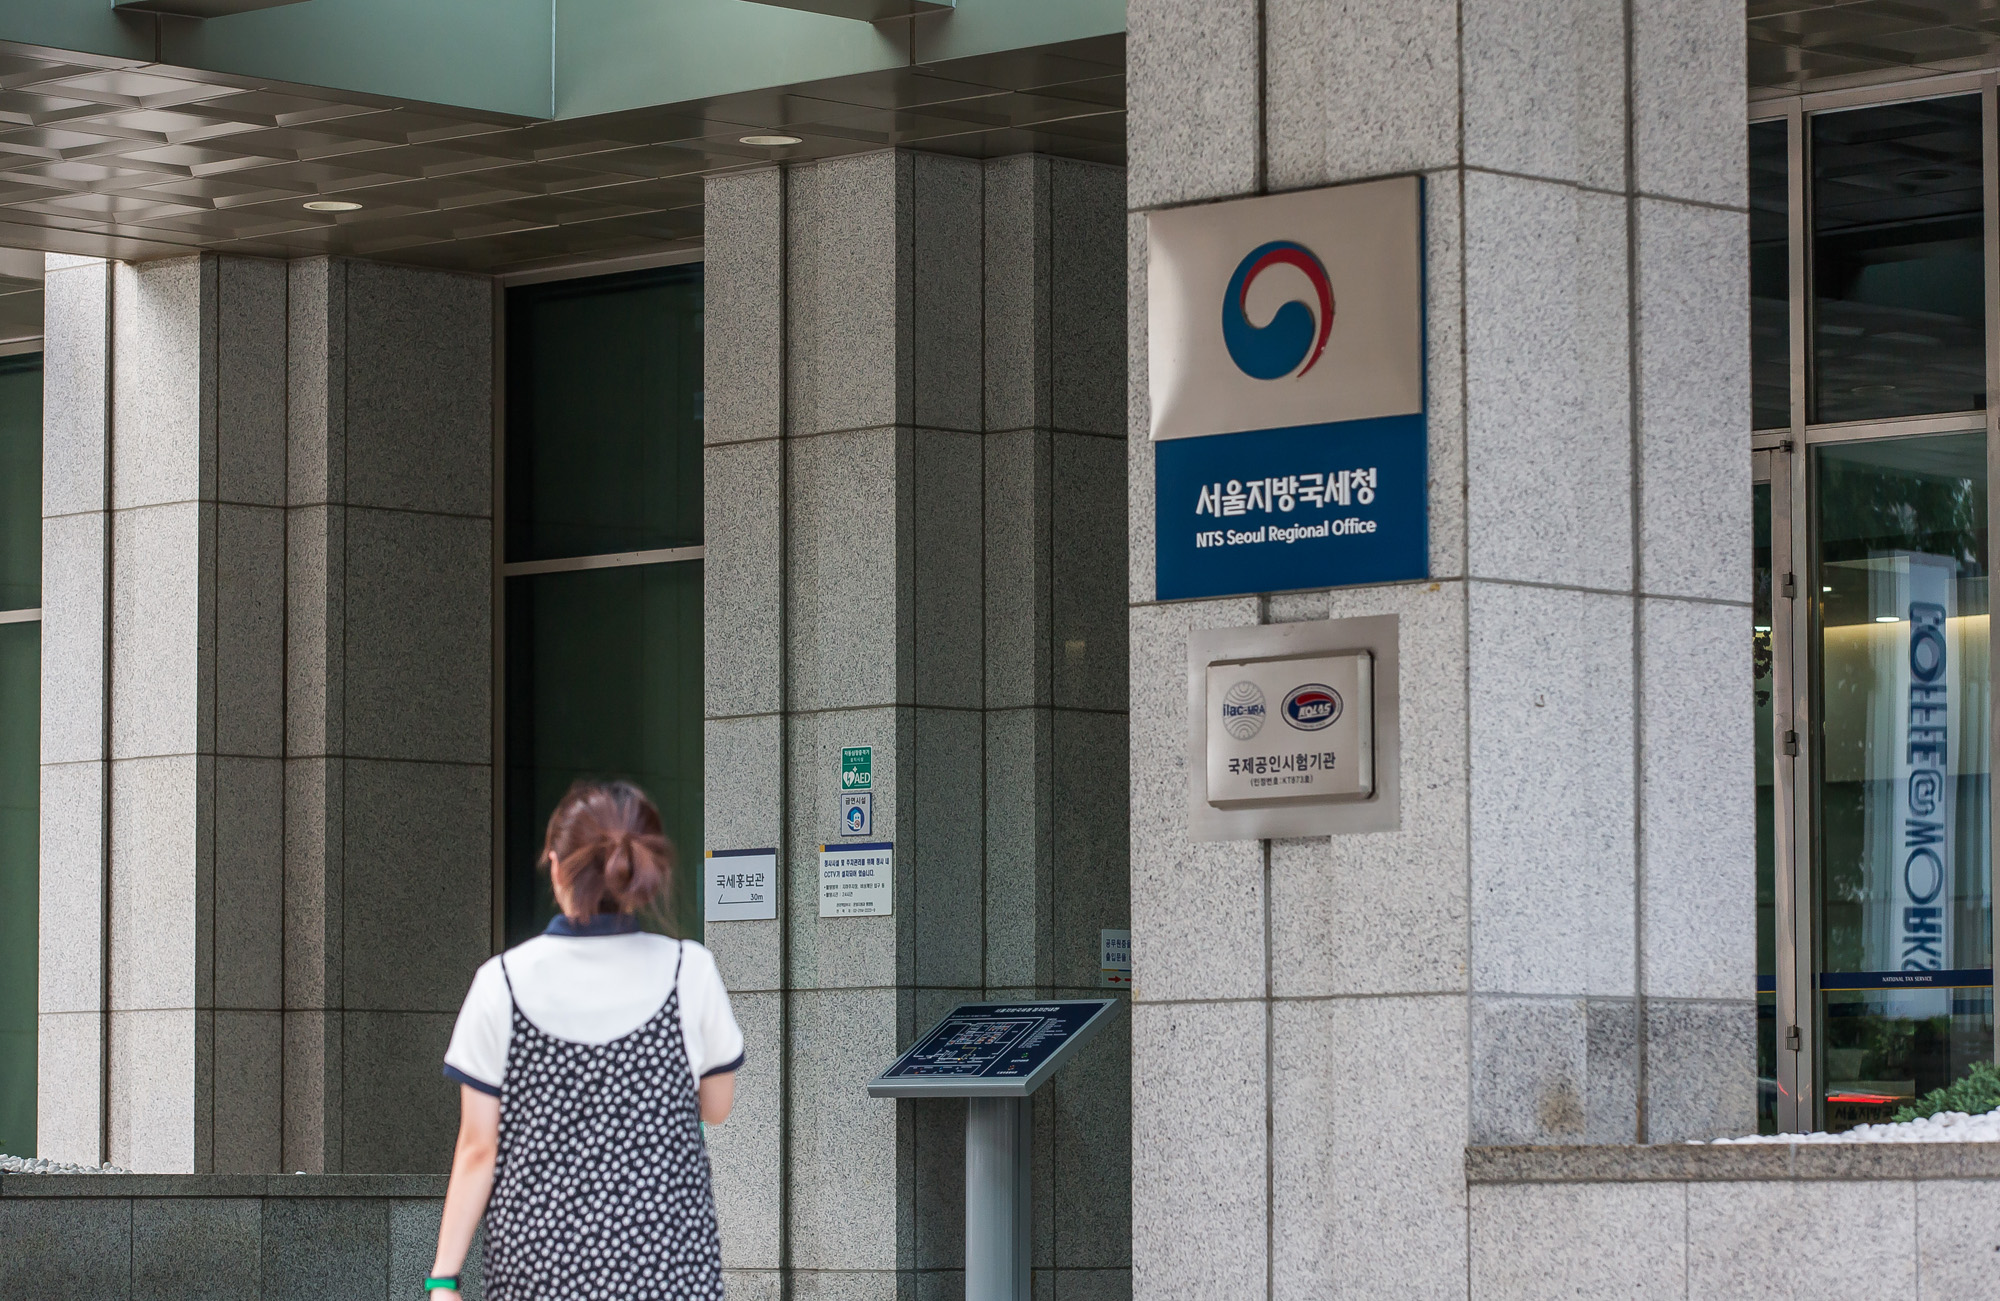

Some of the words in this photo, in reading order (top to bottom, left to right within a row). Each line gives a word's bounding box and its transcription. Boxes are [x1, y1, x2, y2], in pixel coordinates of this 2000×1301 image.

[1195, 467, 1377, 517] 서울지방국세청
[1196, 531, 1224, 548] NTS
[1226, 526, 1265, 545] Seoul
[1268, 520, 1329, 544] Regional
[1332, 517, 1377, 536] Office
[1223, 703, 1266, 717] ilac-MRA
[1228, 752, 1336, 775] 국제공인시험기관
[854, 772, 870, 784] AED
[845, 797, 866, 805] 금연시설
[717, 873, 764, 888] 국세홍보관
